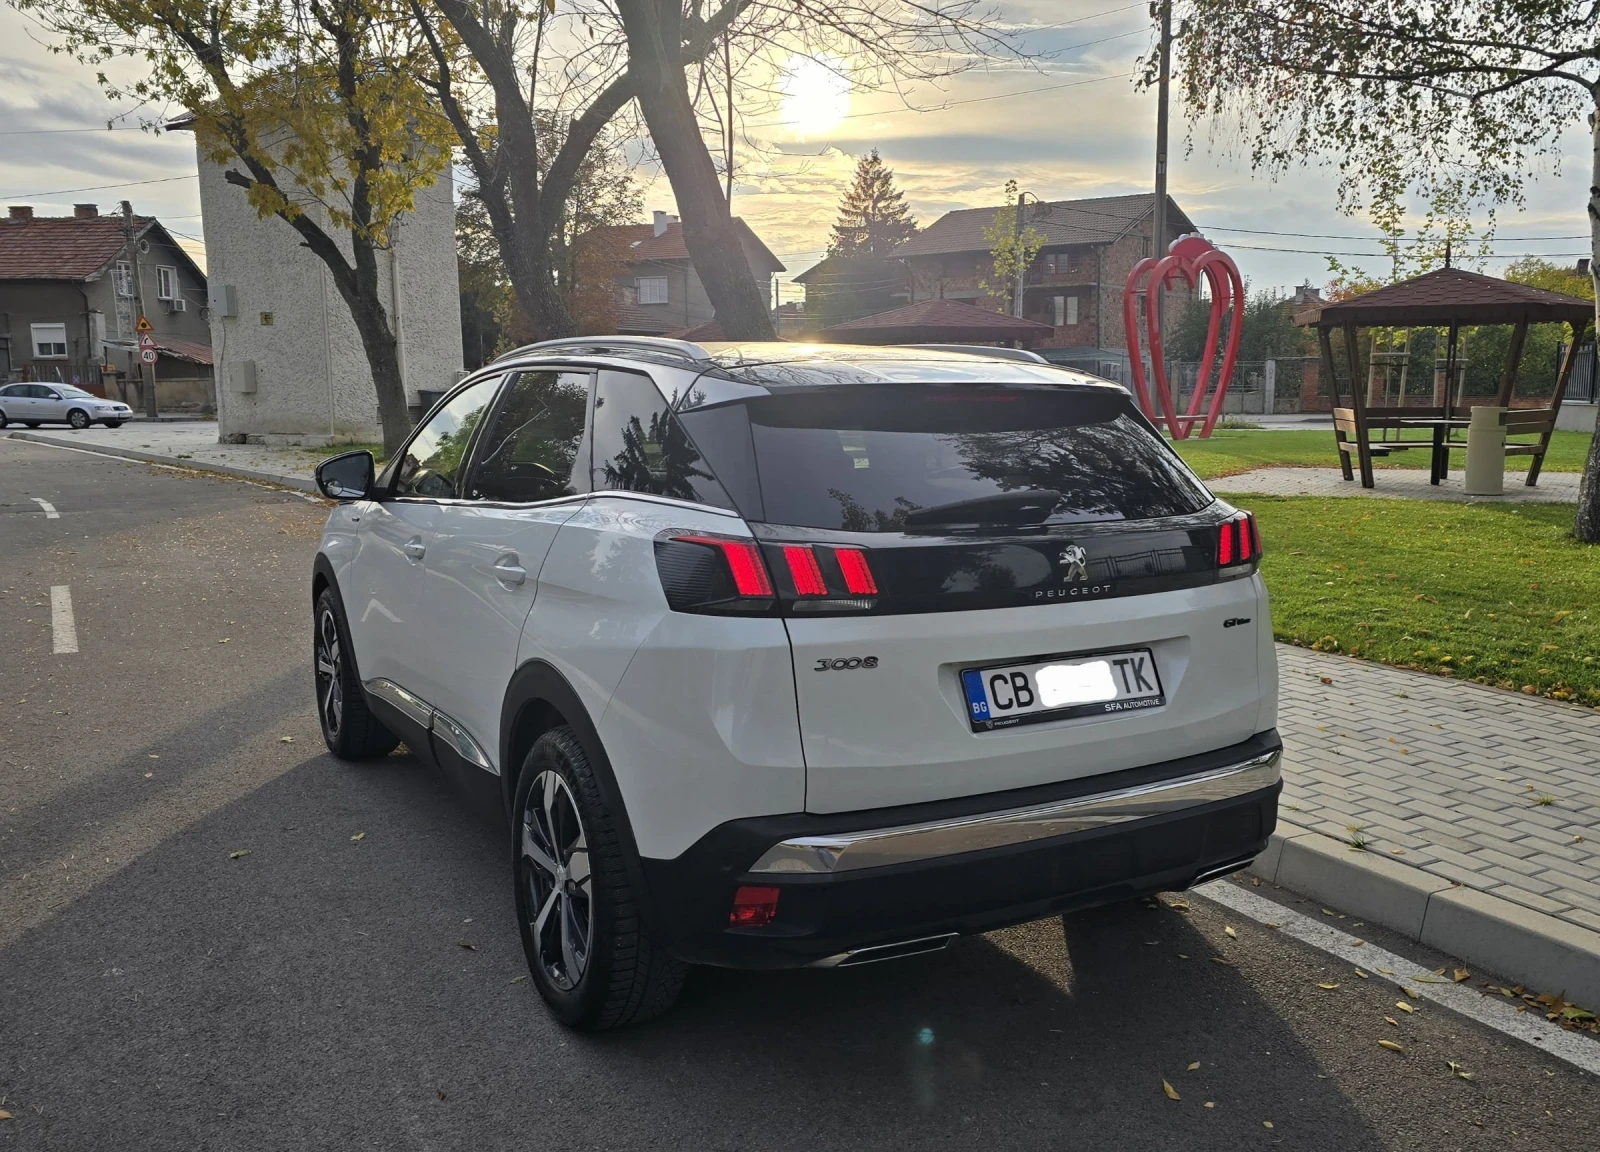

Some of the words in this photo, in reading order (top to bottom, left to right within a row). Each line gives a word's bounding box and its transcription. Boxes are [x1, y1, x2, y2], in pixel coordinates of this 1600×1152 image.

[143, 351, 154, 360] 40
[1035, 585, 1111, 598] PEUGEOT
[814, 656, 878, 671] 3008
[989, 671, 1034, 710] CB
[1113, 657, 1153, 693] TK
[973, 702, 987, 714] BG
[1104, 702, 1123, 712] SFA
[1123, 698, 1160, 709] AUTOMOTIVE
